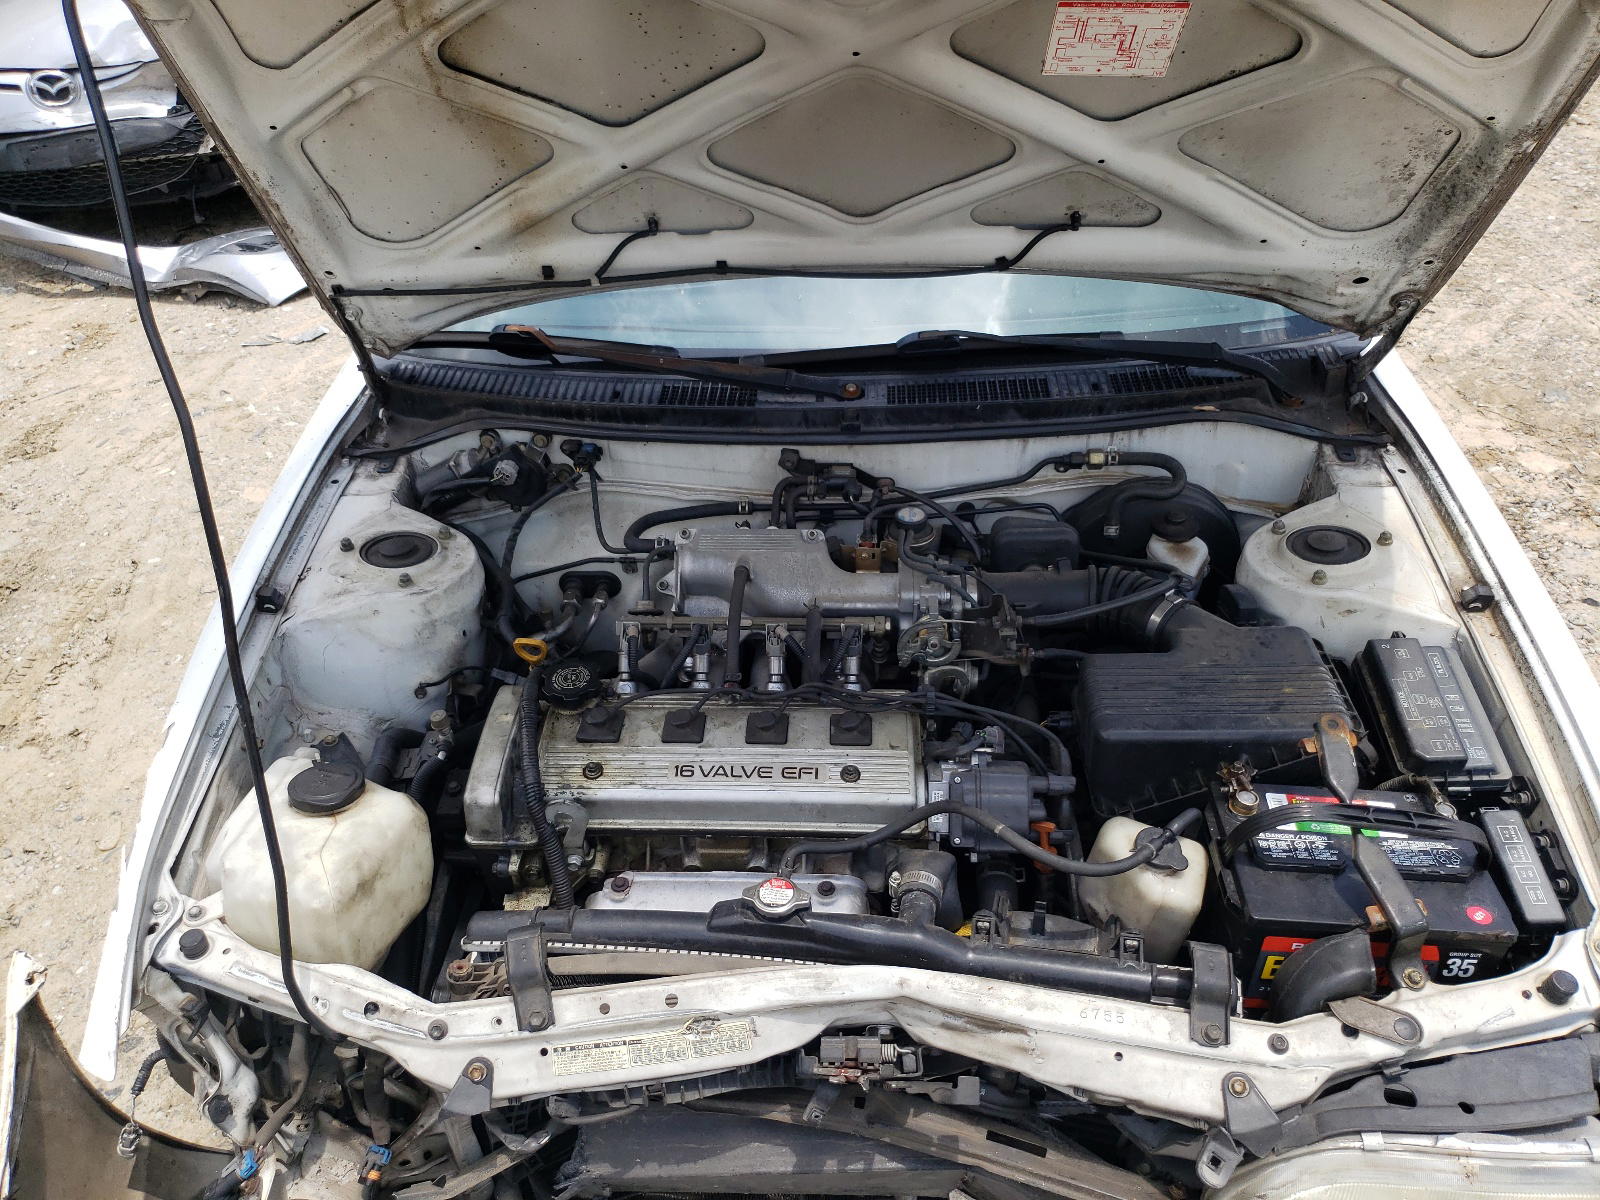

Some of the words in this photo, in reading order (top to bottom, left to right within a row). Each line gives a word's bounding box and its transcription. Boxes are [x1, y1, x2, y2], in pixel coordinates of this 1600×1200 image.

[674, 764, 695, 778] 16
[699, 764, 774, 779] VALVE
[781, 766, 819, 780] EFI
[1265, 832, 1295, 840] DANGER
[1442, 958, 1478, 977] 35
